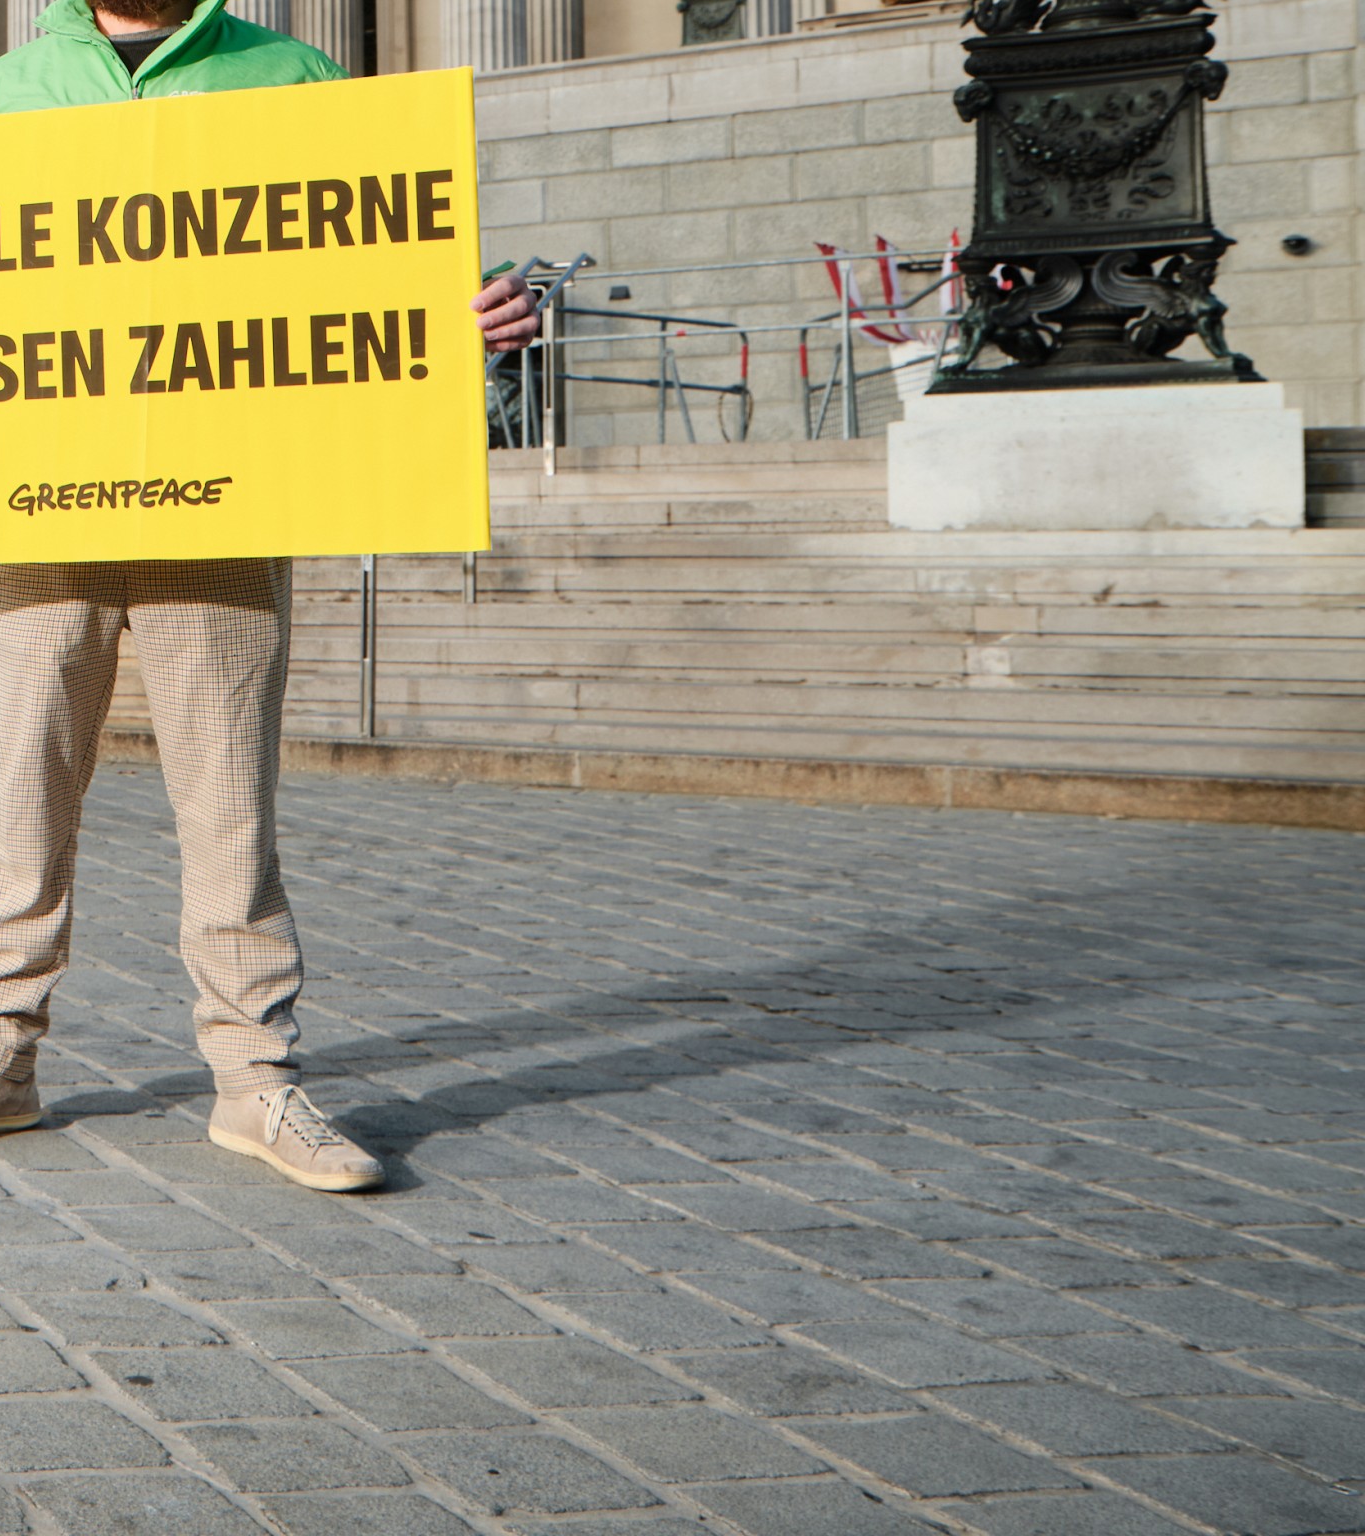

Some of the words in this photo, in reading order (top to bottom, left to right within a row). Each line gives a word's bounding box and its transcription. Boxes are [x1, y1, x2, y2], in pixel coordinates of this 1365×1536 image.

[77, 169, 455, 266] KONZERNE
[129, 308, 428, 394] ZAHLEN!
[8, 476, 233, 516] GREENPEACE
